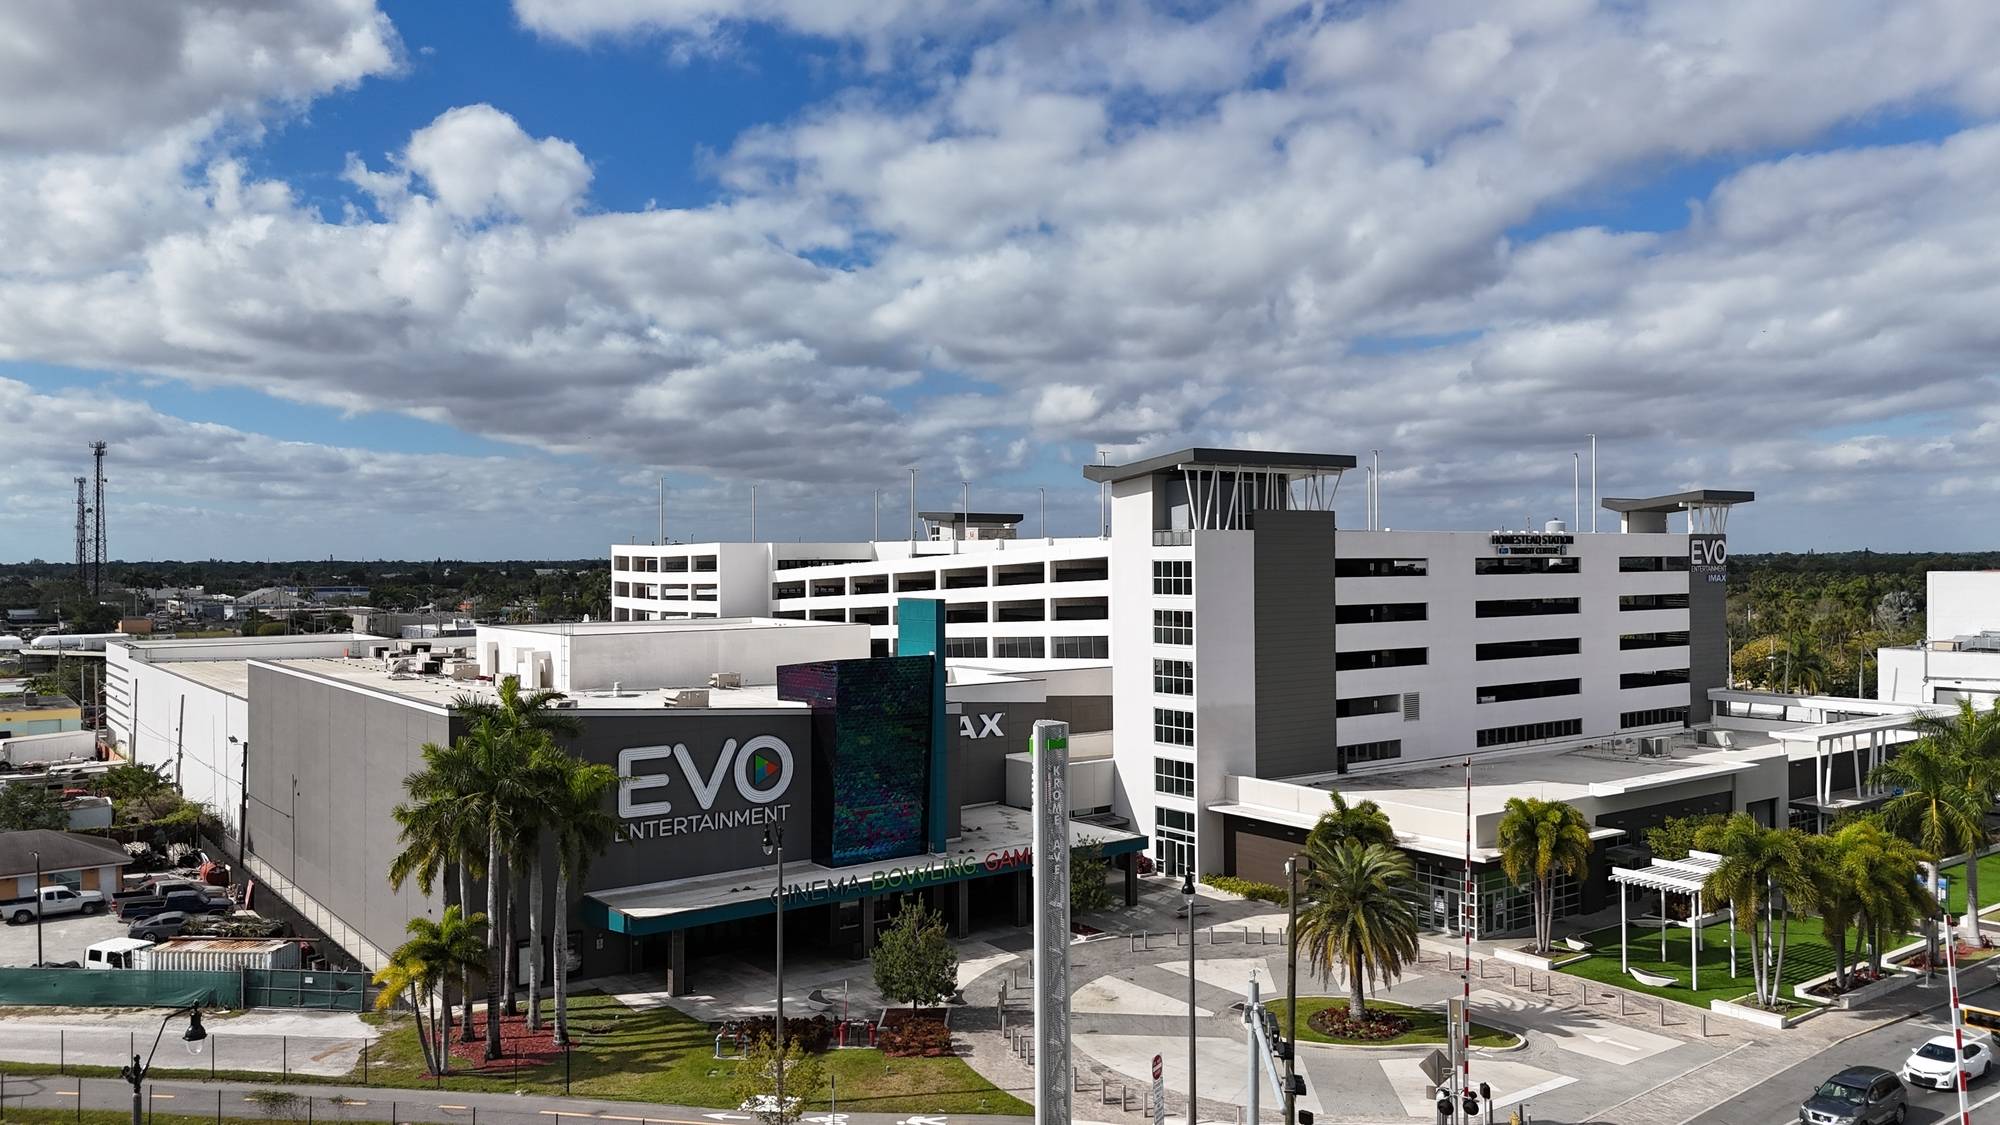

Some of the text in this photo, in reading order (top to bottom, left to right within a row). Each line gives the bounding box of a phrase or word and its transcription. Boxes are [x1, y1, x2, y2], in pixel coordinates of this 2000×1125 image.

[1542, 535, 1574, 545] STATION
[1691, 539, 1727, 565] EVO
[1708, 574, 1727, 582] IMAX
[960, 712, 1004, 739] AX
[618, 735, 794, 819] EVO
[614, 804, 791, 843] ENTERTAINMENT
[1052, 765, 1062, 875] KROME AVE
